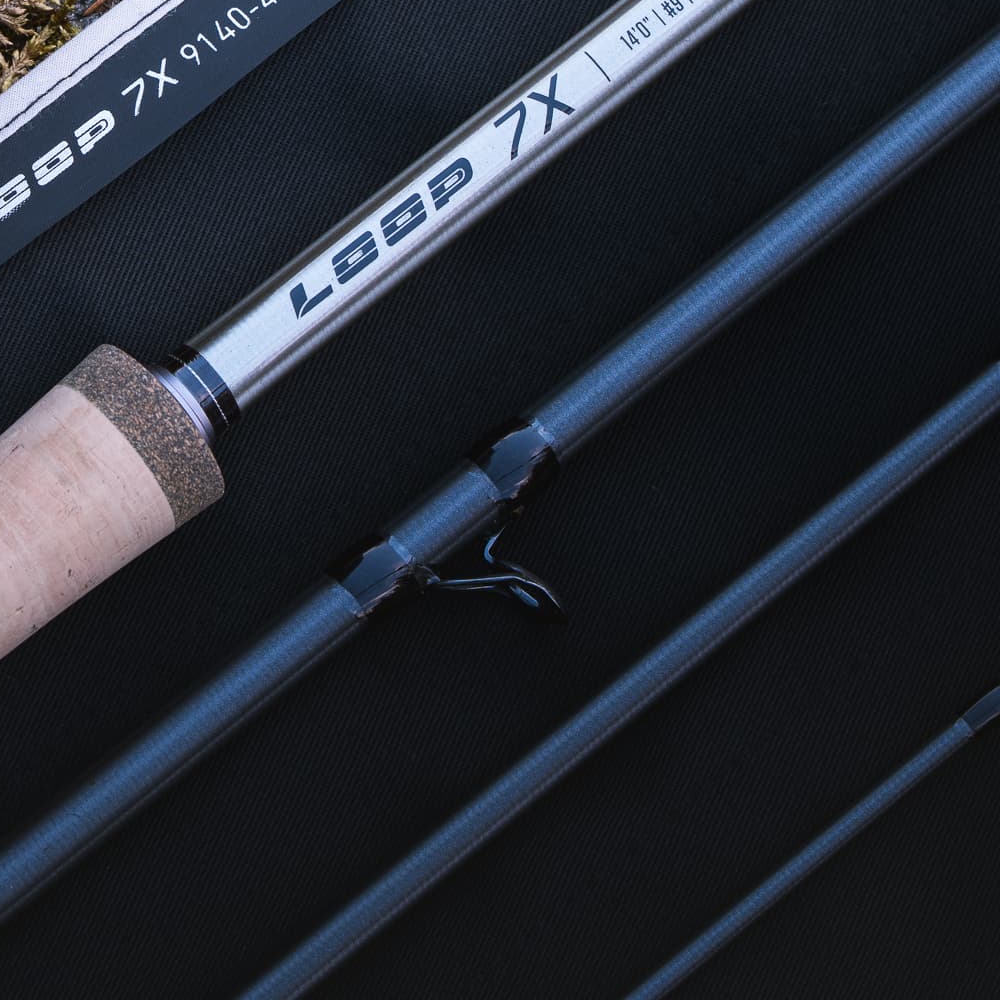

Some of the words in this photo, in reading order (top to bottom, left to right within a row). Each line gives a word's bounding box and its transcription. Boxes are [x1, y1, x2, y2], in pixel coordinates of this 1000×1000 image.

[121, 57, 179, 116] 7X
[289, 157, 473, 320] LOOP
[493, 73, 576, 160] 7X
